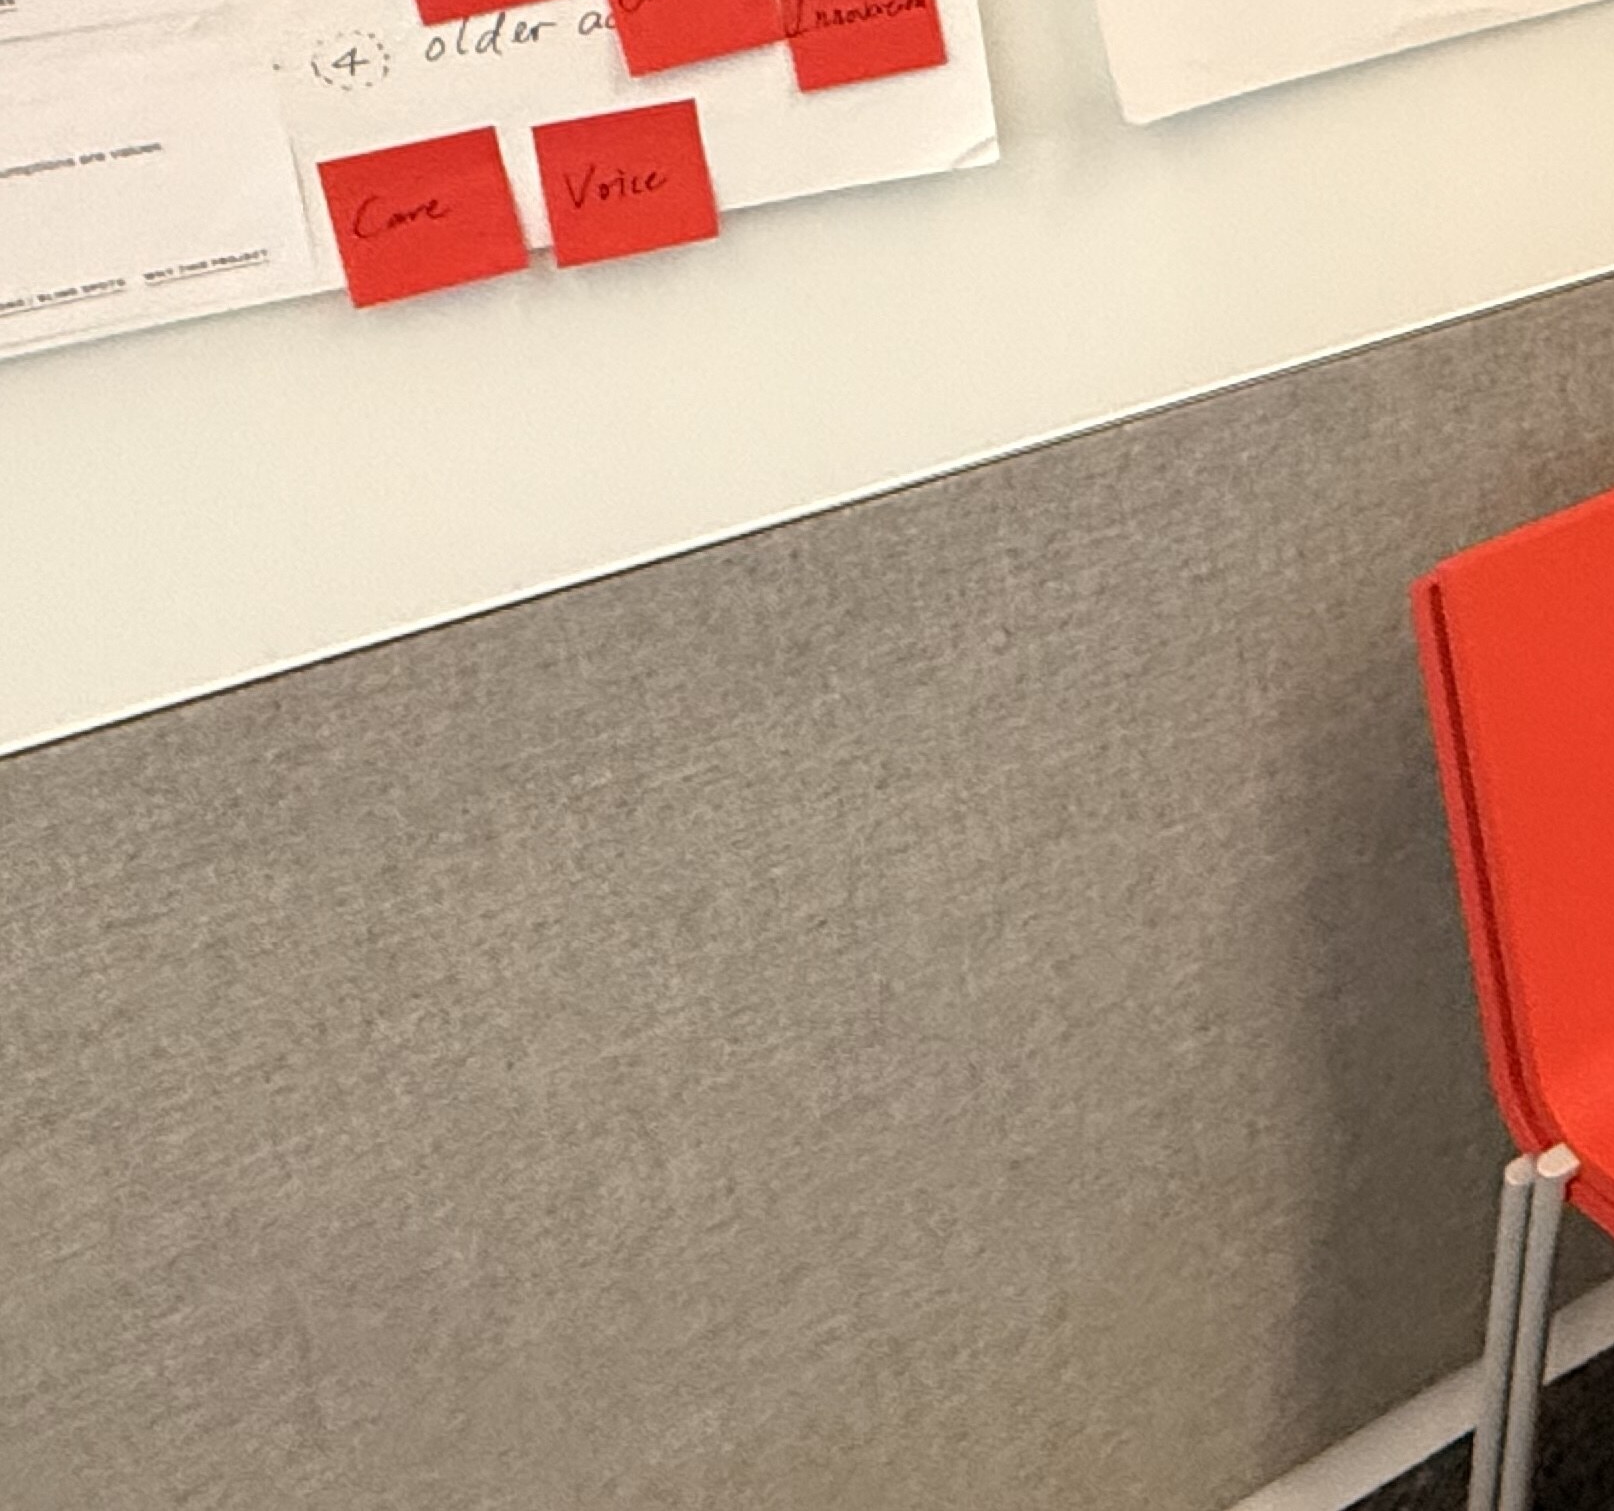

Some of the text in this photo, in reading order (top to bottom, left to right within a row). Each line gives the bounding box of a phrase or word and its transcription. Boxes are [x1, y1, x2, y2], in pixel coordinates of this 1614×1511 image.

[425, 17, 555, 62] older
[566, 166, 670, 210] Voice
[352, 195, 452, 240] Care
